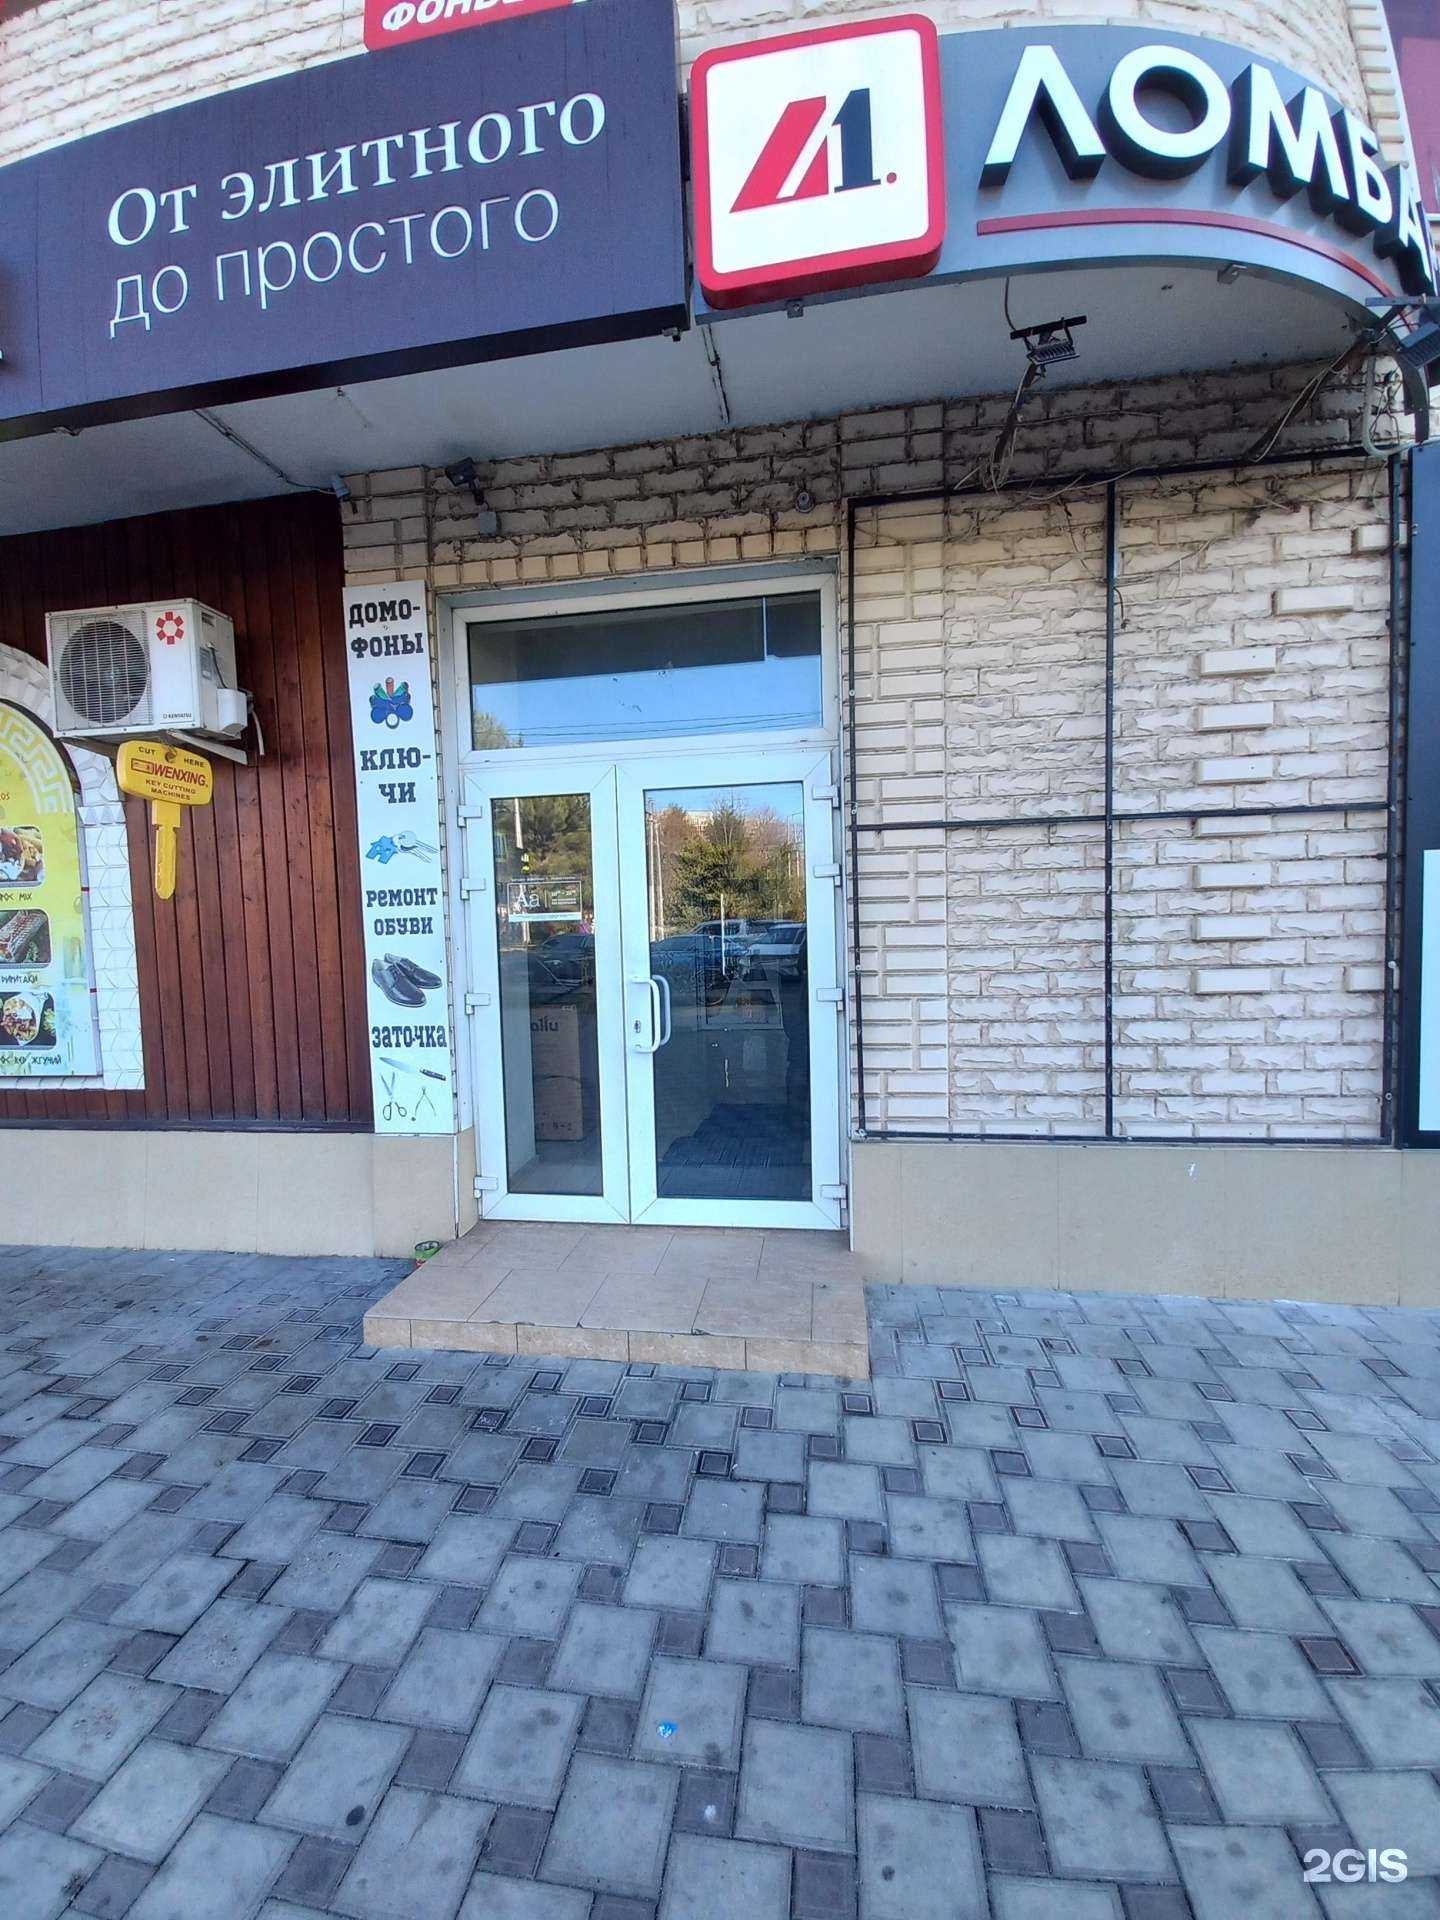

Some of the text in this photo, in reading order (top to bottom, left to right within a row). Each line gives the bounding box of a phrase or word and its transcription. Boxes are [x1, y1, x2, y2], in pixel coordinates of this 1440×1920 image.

[108, 92, 607, 246] От элитного
[109, 189, 559, 339] до простого
[348, 599, 421, 629] ДОМО-
[350, 633, 424, 658] ФОНЫ
[138, 746, 206, 768] CUT HERE
[360, 747, 431, 771] КЛЮ-
[145, 779, 197, 794] KEY CUTTING
[151, 787, 191, 800] MACHINES
[378, 782, 417, 803] ЧИ
[374, 917, 434, 936] ОБУВИ
